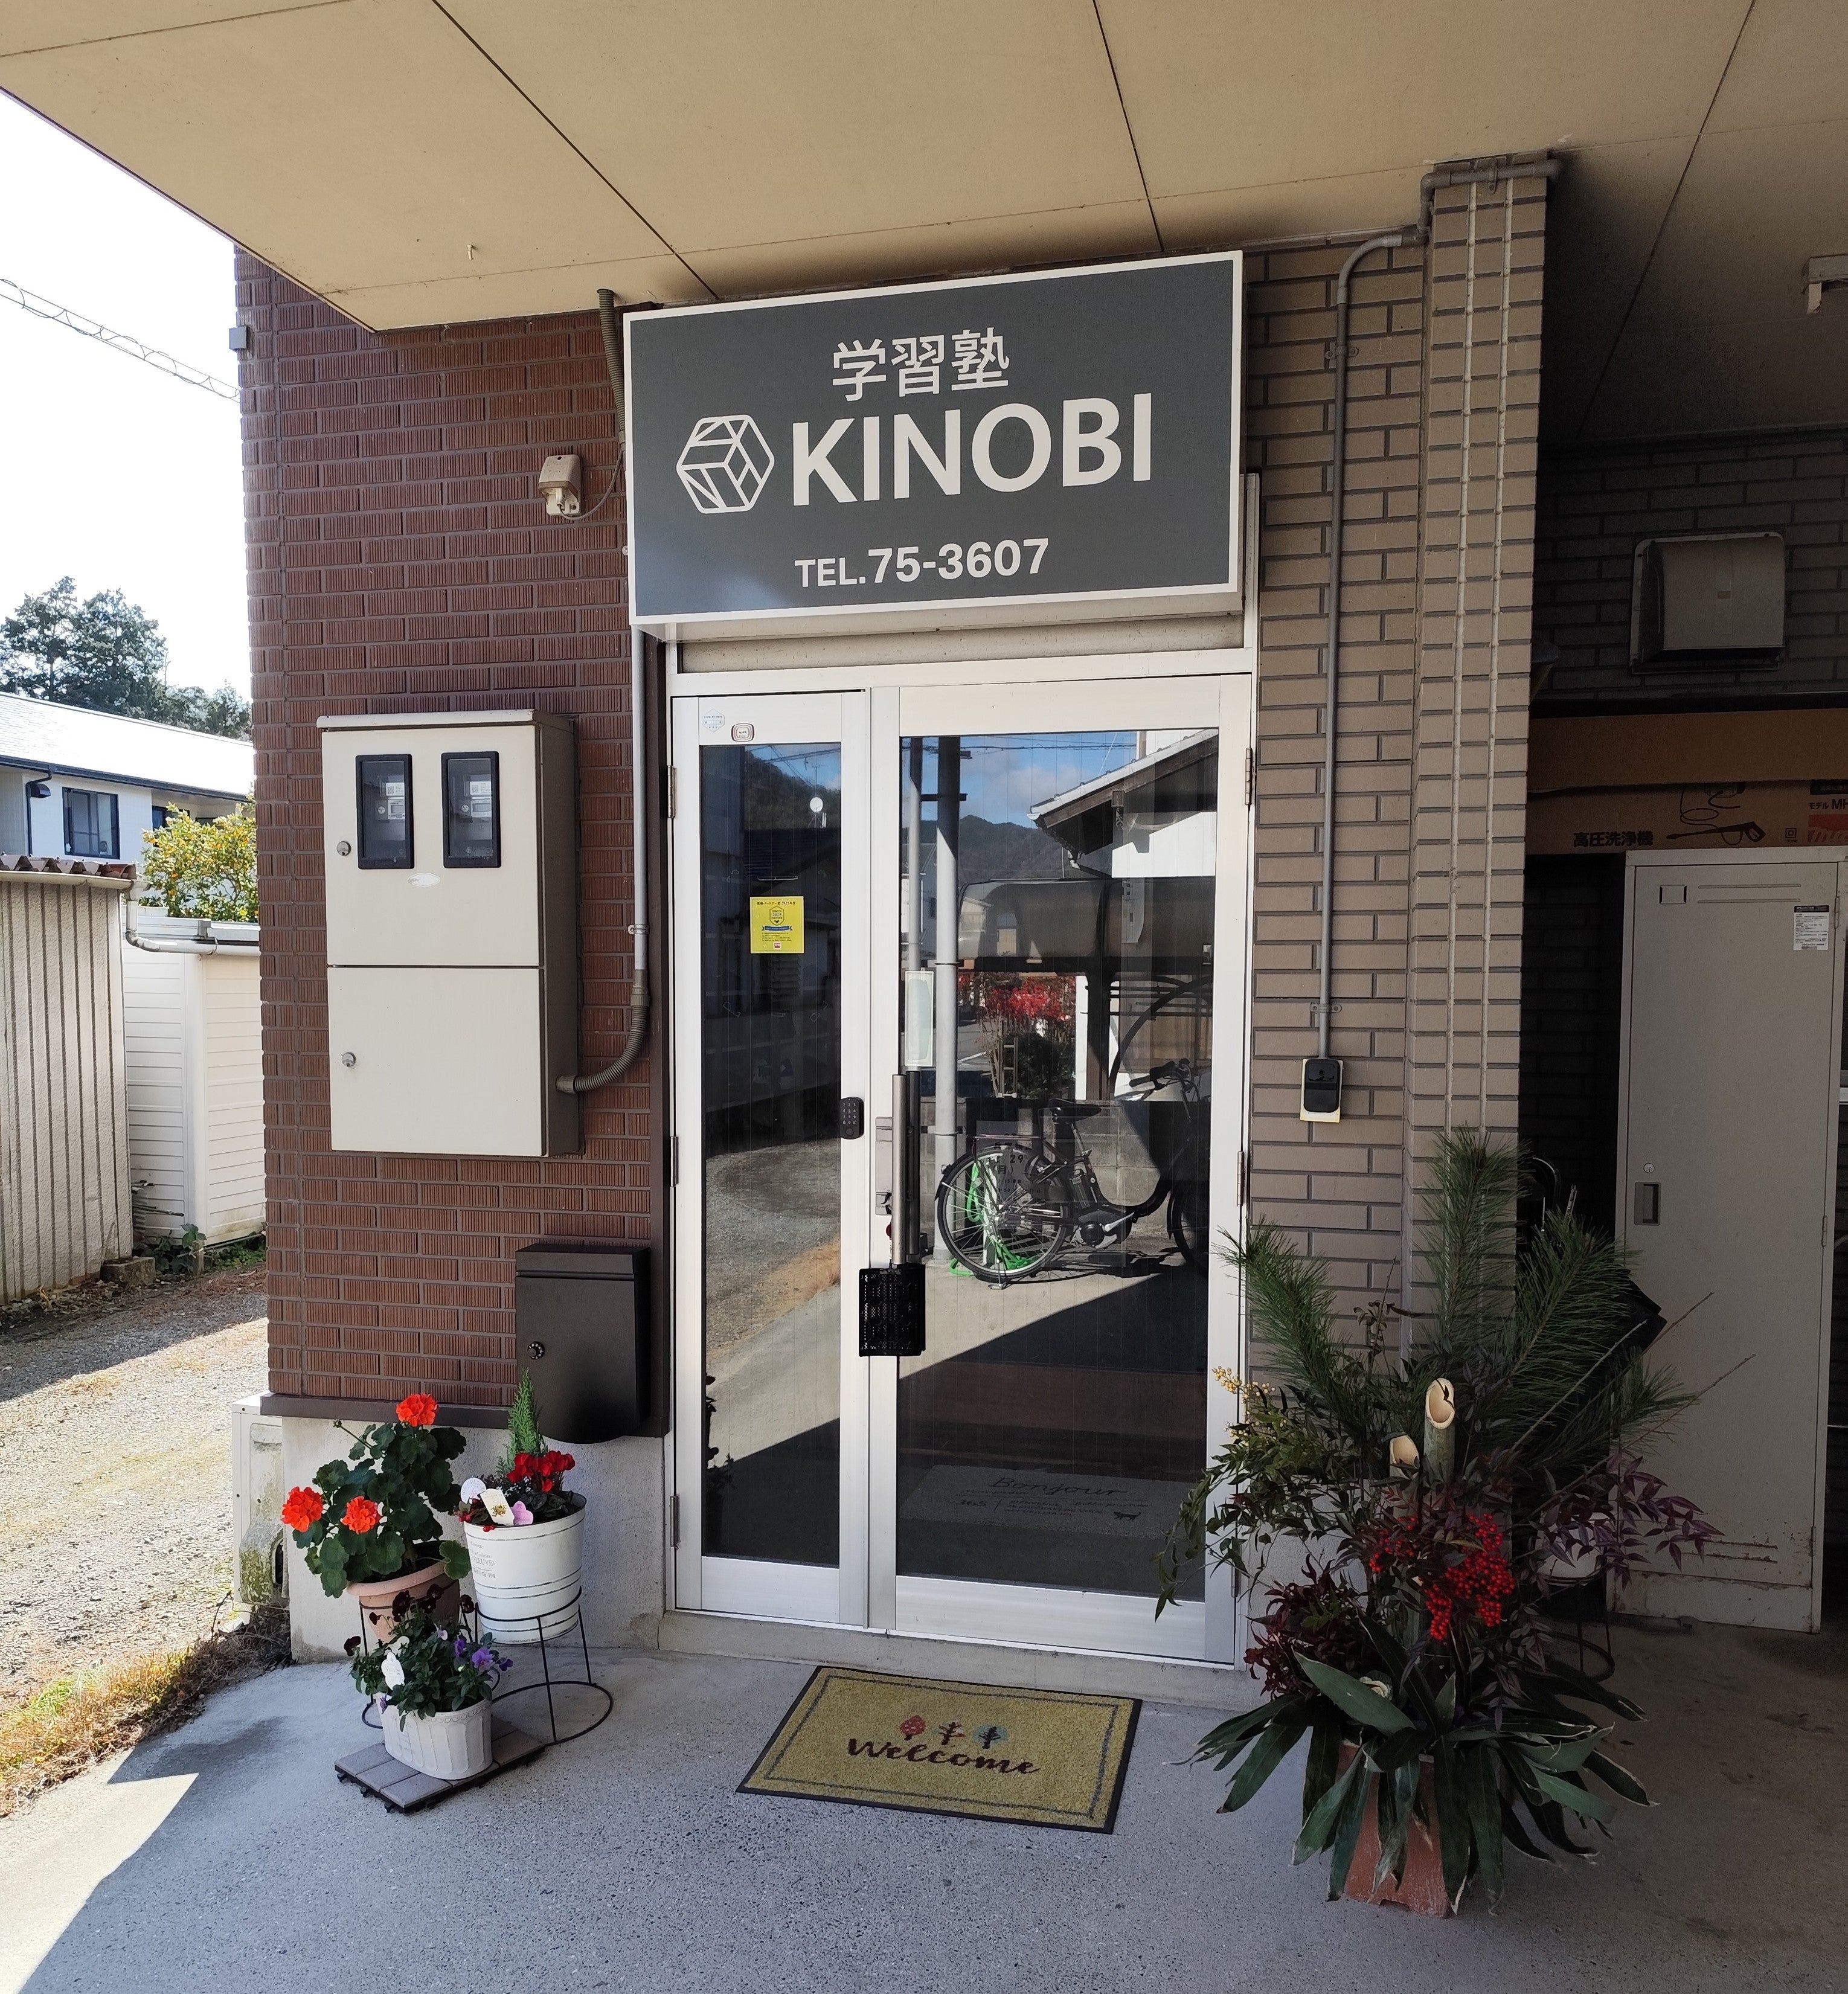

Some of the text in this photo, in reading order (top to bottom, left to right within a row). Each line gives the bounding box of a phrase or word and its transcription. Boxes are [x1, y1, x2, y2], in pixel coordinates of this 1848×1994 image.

[832, 327, 1010, 402] 学習塾
[792, 393, 1152, 506] KINOBI
[1809, 801, 1829, 810] モデル
[1573, 830, 1654, 848] 高圧洗浄機
[987, 1476, 1128, 1496] Bonjour
[847, 1737, 1041, 1775] Welcome
